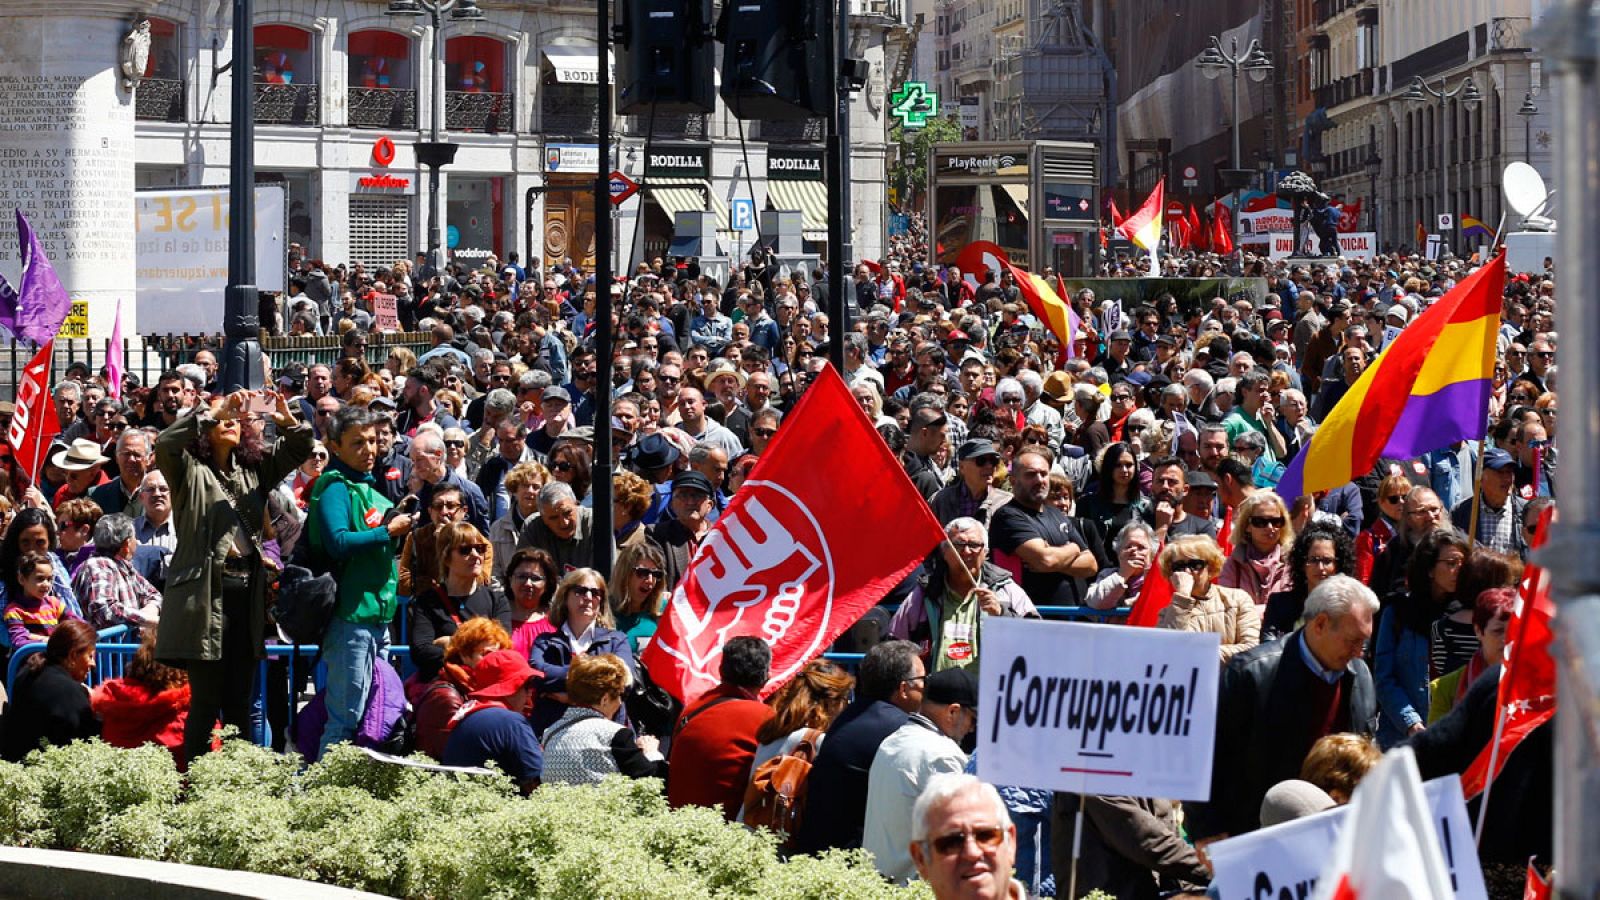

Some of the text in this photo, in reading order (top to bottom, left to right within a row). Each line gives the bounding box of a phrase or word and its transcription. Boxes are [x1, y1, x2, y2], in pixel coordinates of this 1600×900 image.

[650, 155, 704, 168] RODILLA
[769, 158, 821, 170] RODILLA
[949, 156, 999, 170] PlayRenfe
[359, 174, 410, 189] vodafone
[16, 190, 36, 199] LOS
[991, 655, 1199, 751] ¡Corruppción!
